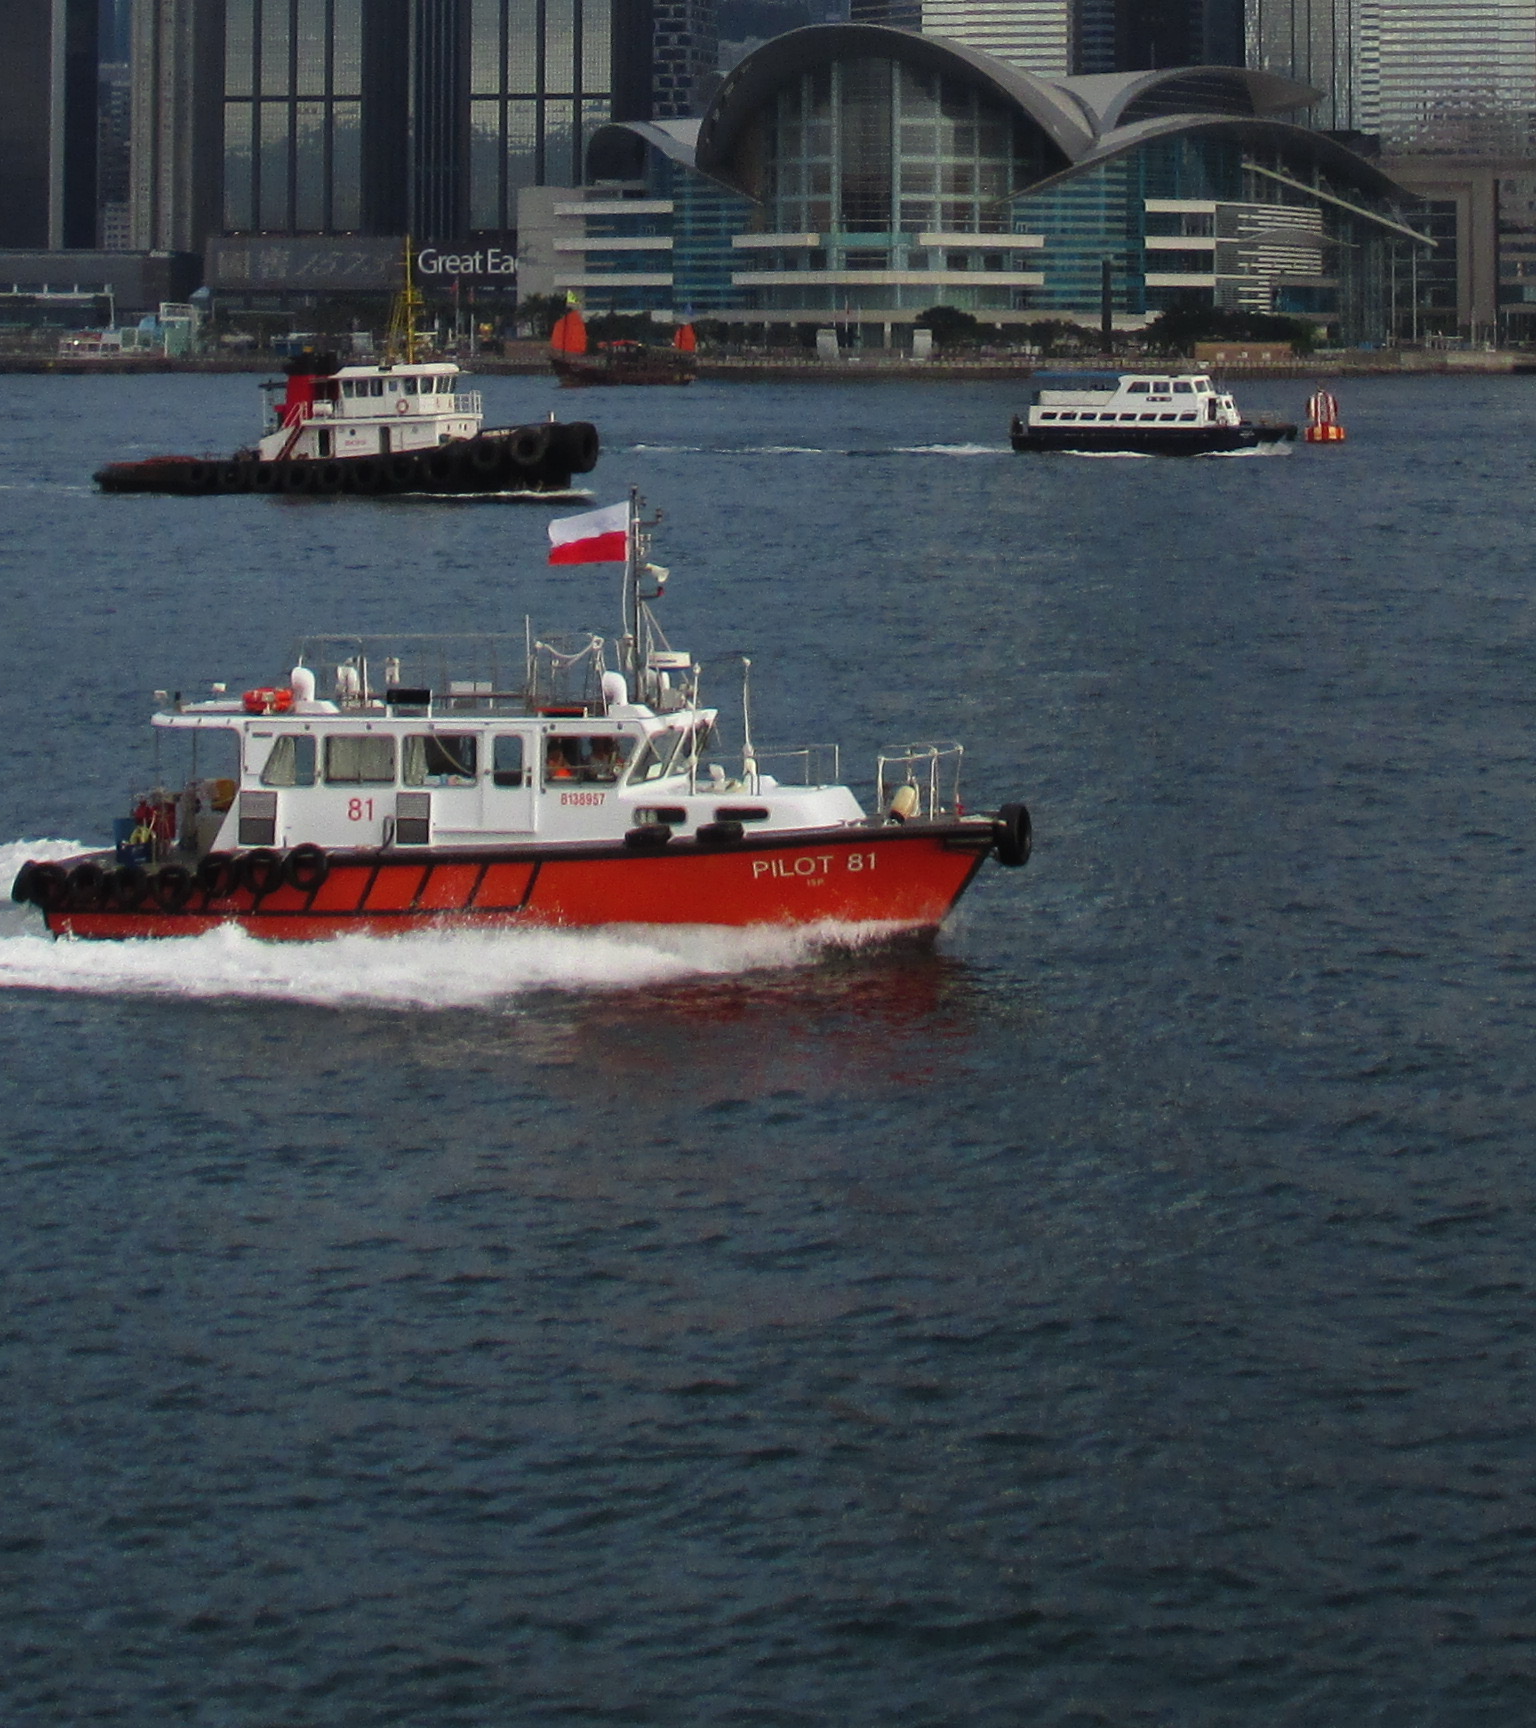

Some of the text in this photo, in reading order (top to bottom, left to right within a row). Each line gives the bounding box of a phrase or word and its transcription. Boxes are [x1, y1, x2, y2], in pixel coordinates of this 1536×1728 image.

[418, 248, 483, 274] Great
[487, 249, 518, 274] Ea
[347, 798, 374, 821] 81
[752, 852, 877, 879] PILOT 81
